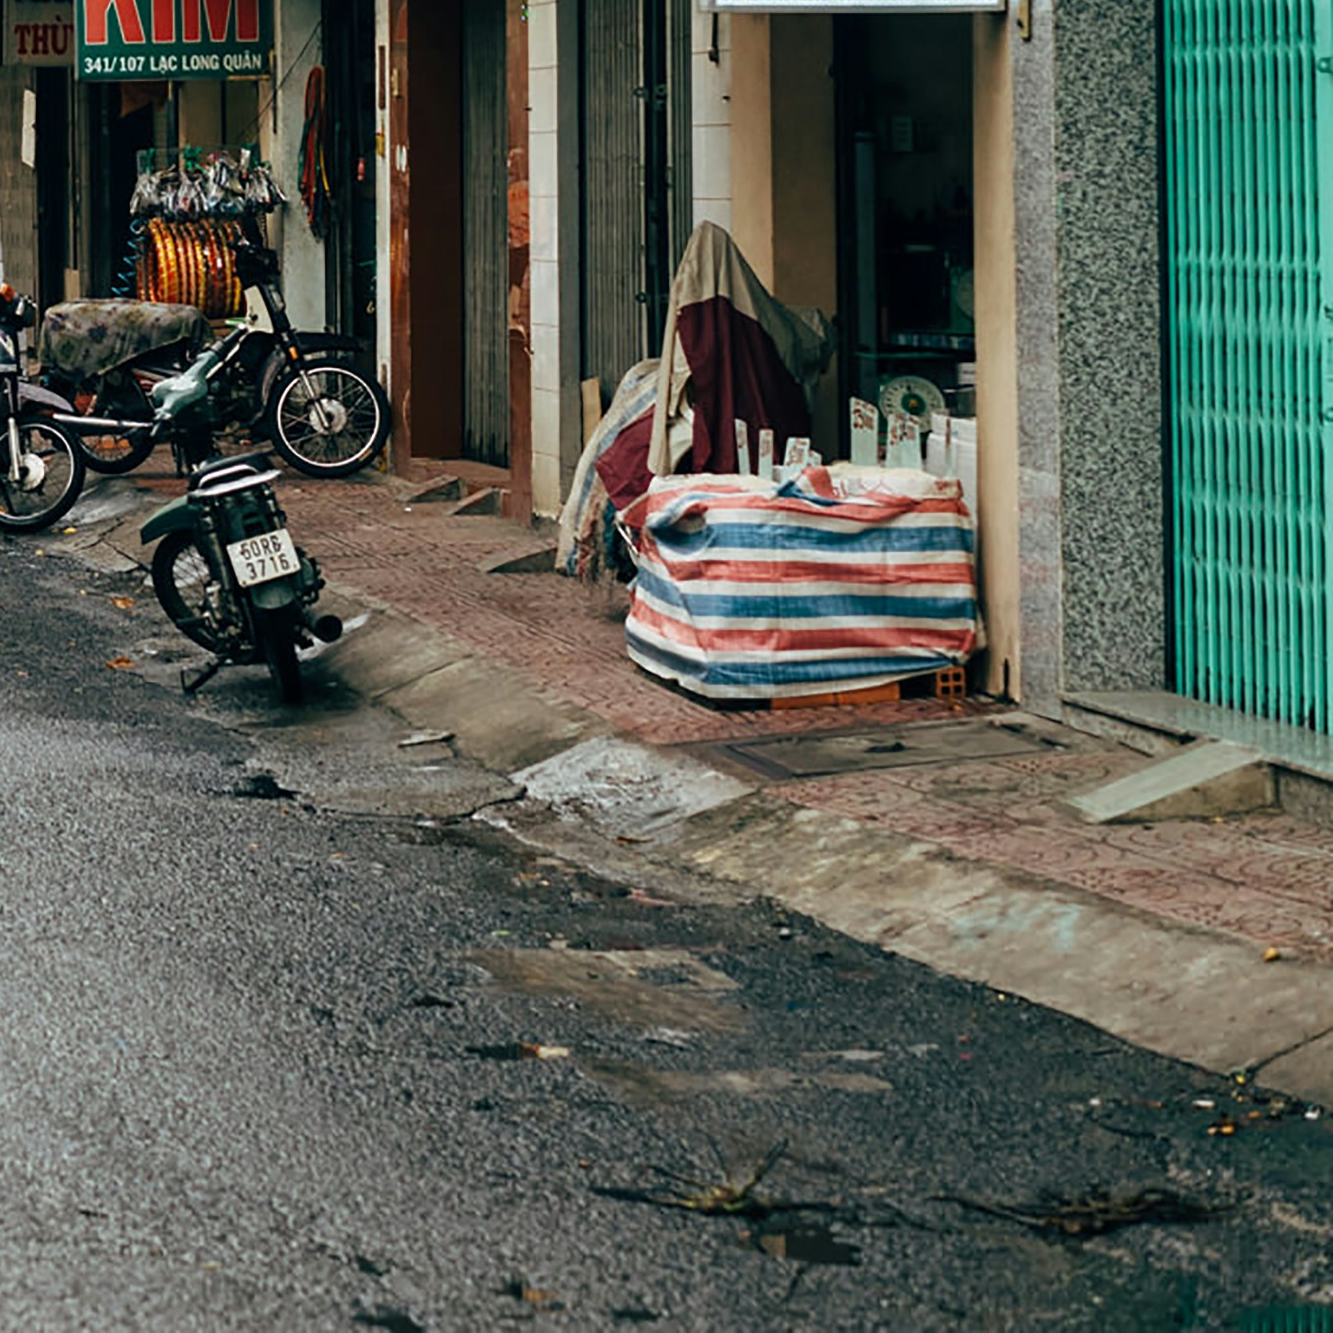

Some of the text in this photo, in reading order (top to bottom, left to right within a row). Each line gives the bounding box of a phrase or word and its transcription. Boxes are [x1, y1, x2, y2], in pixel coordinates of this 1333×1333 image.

[14, 14, 73, 55] THÙ
[84, 50, 262, 74] 341/107 LẠC LONG QUÂN
